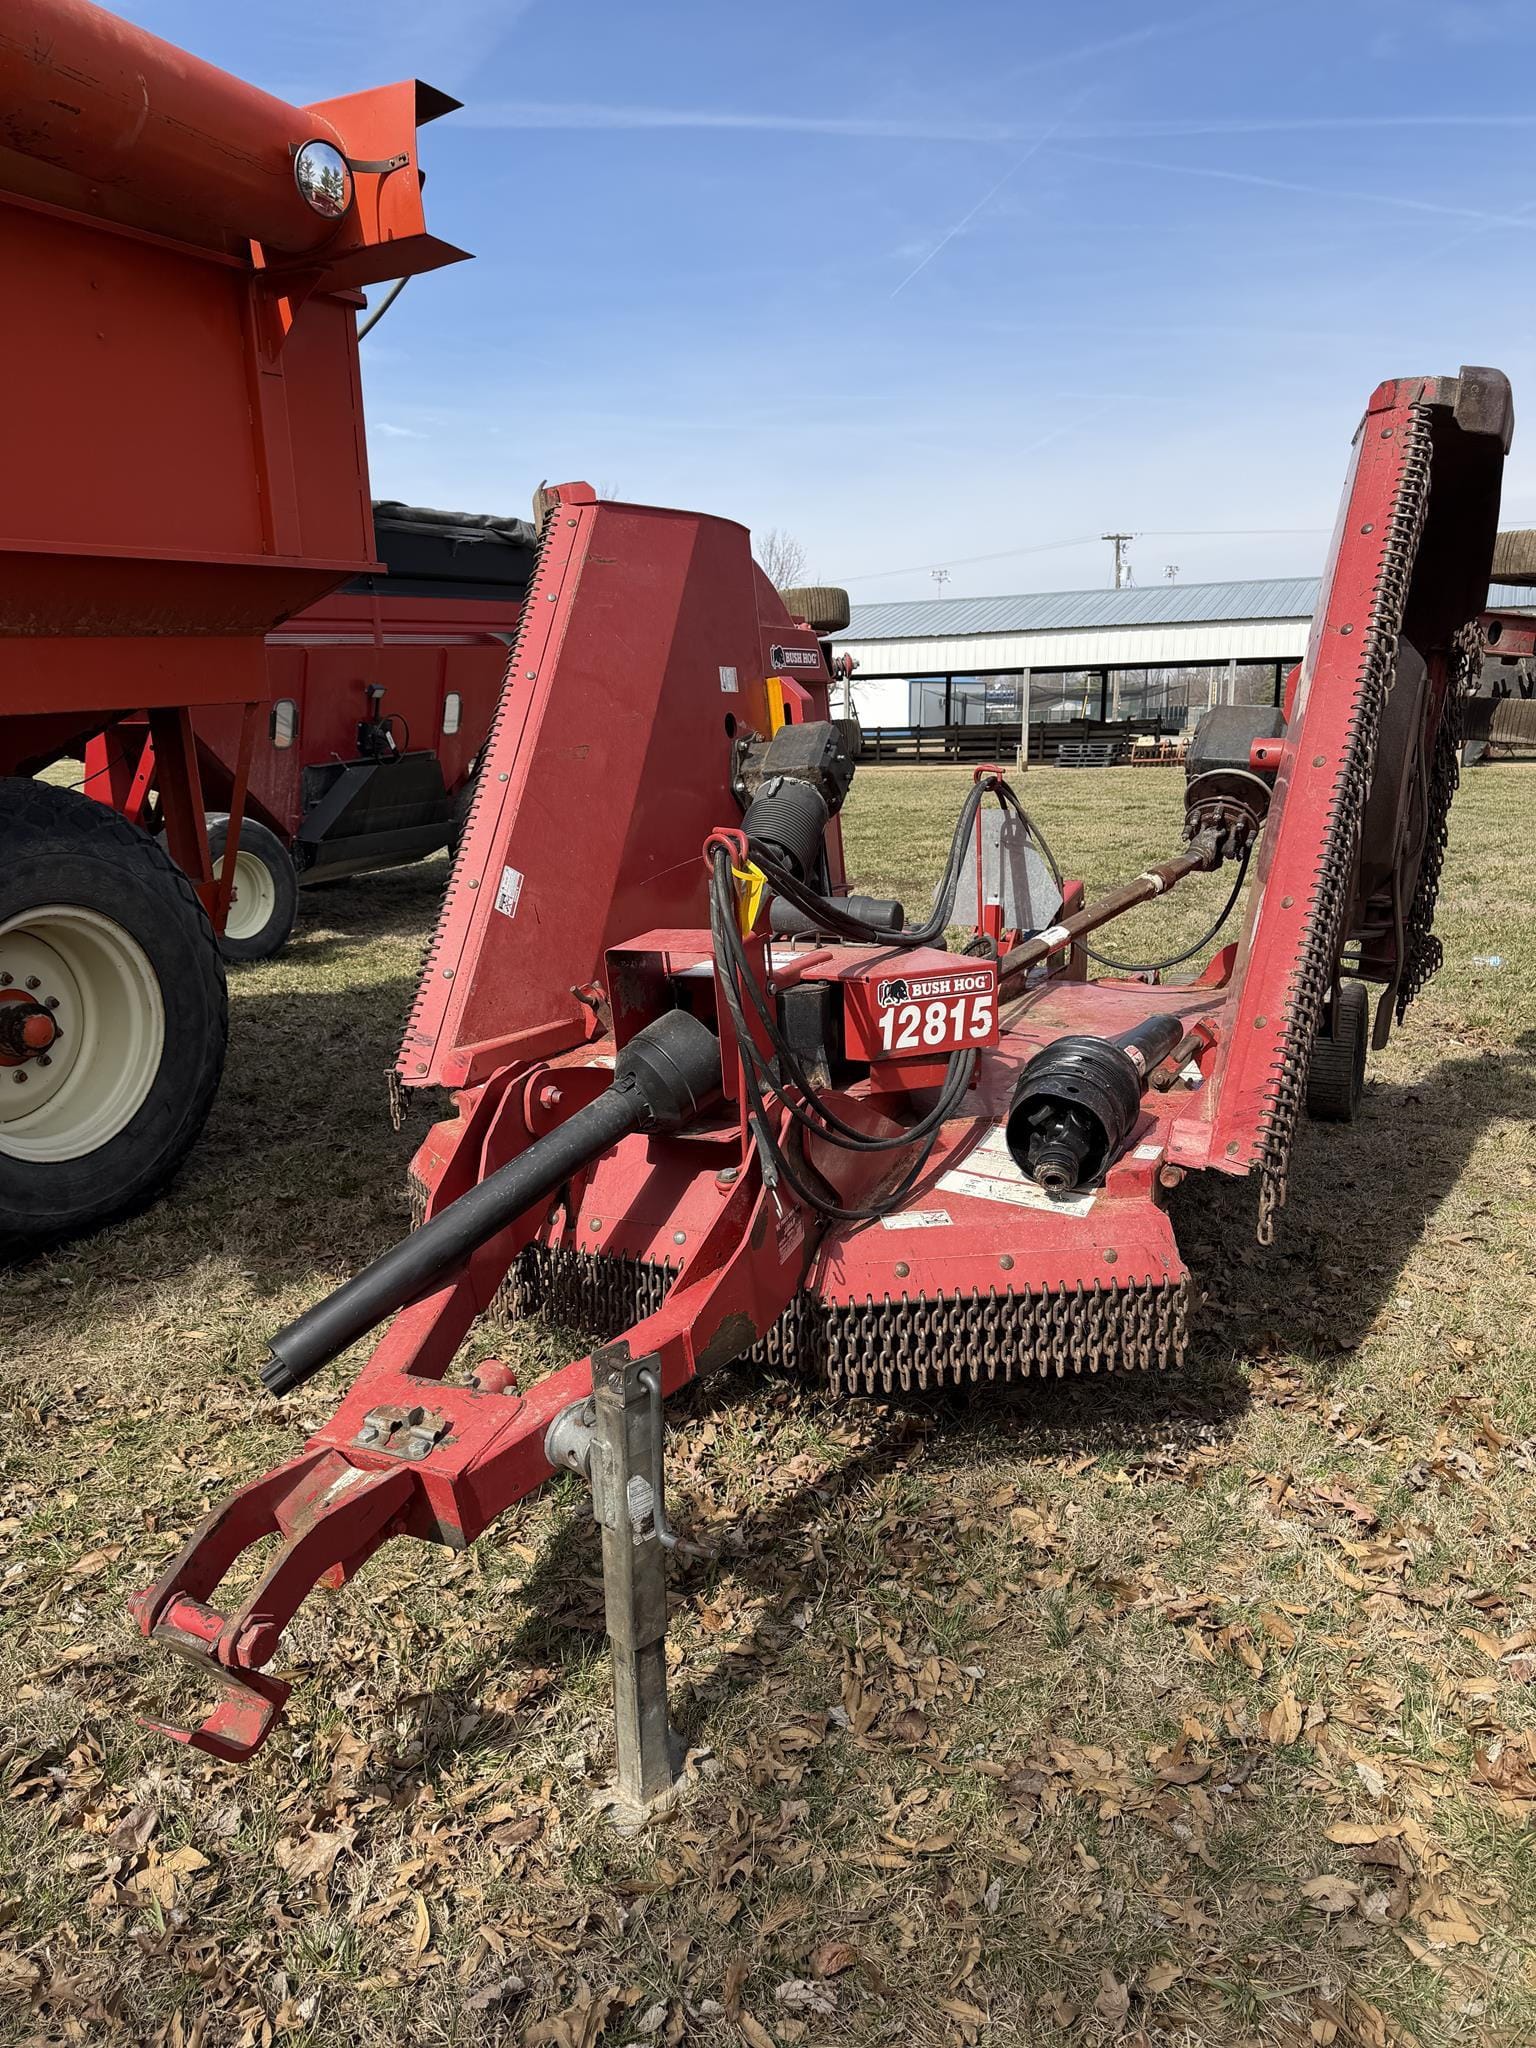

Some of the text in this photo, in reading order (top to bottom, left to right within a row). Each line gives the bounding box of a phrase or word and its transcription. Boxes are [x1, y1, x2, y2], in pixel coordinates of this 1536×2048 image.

[785, 652, 817, 664] BUSH HOG
[911, 975, 987, 997] BUSH HOG
[879, 996, 993, 1051] 12815
